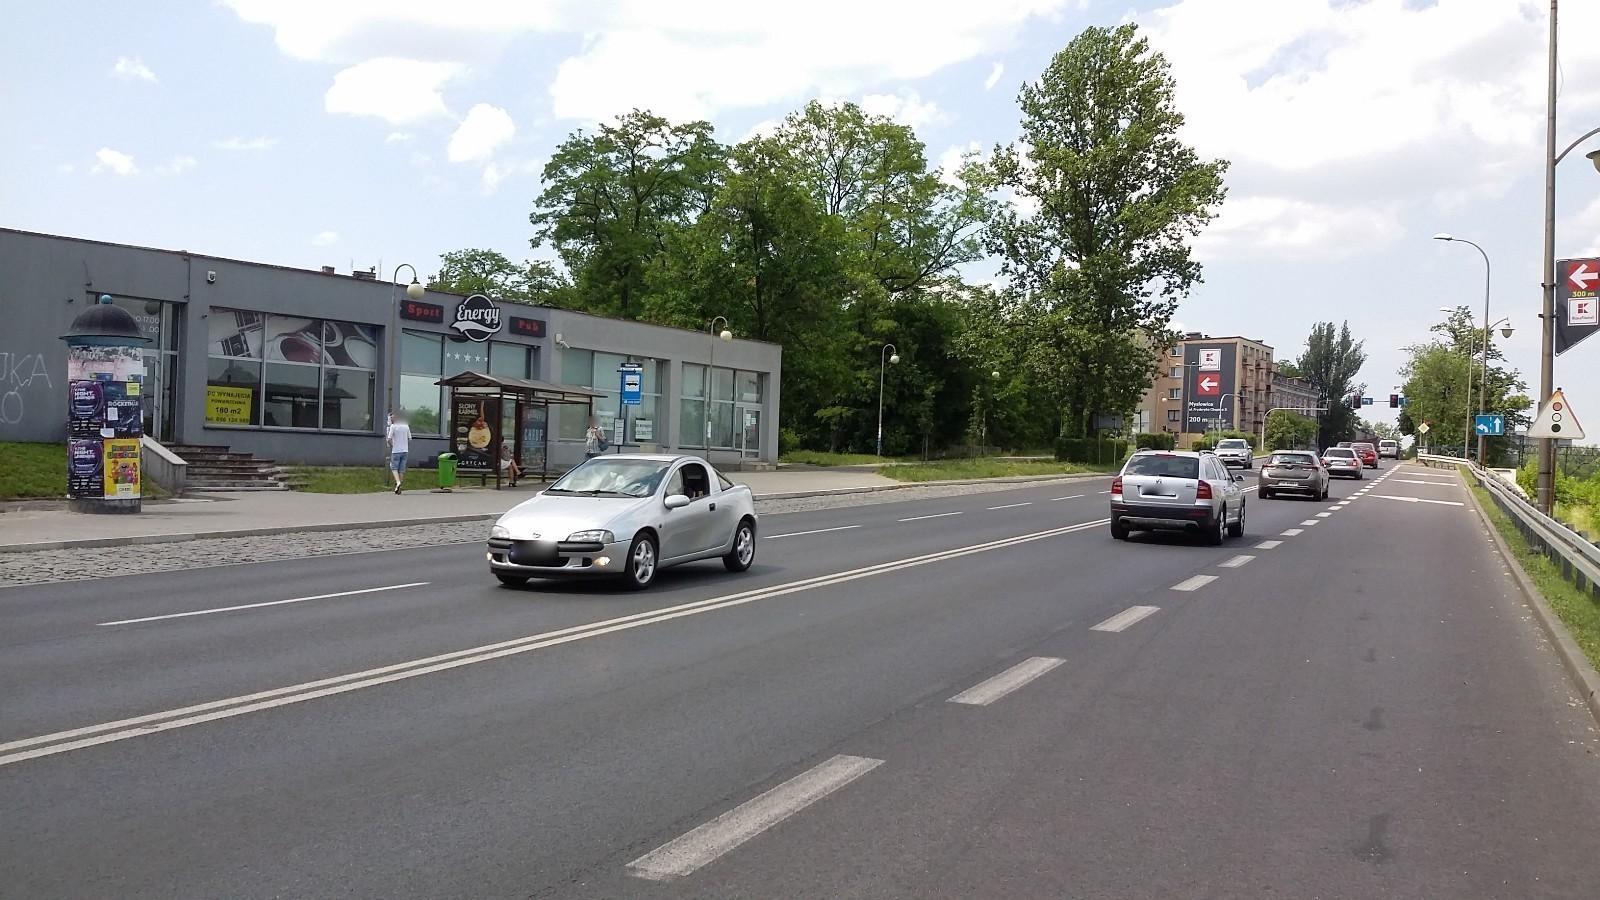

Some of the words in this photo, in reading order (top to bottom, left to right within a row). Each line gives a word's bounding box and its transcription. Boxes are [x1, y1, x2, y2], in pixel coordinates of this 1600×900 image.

[407, 303, 440, 317] Sport
[457, 304, 500, 324] Energy
[518, 320, 539, 332] Pub
